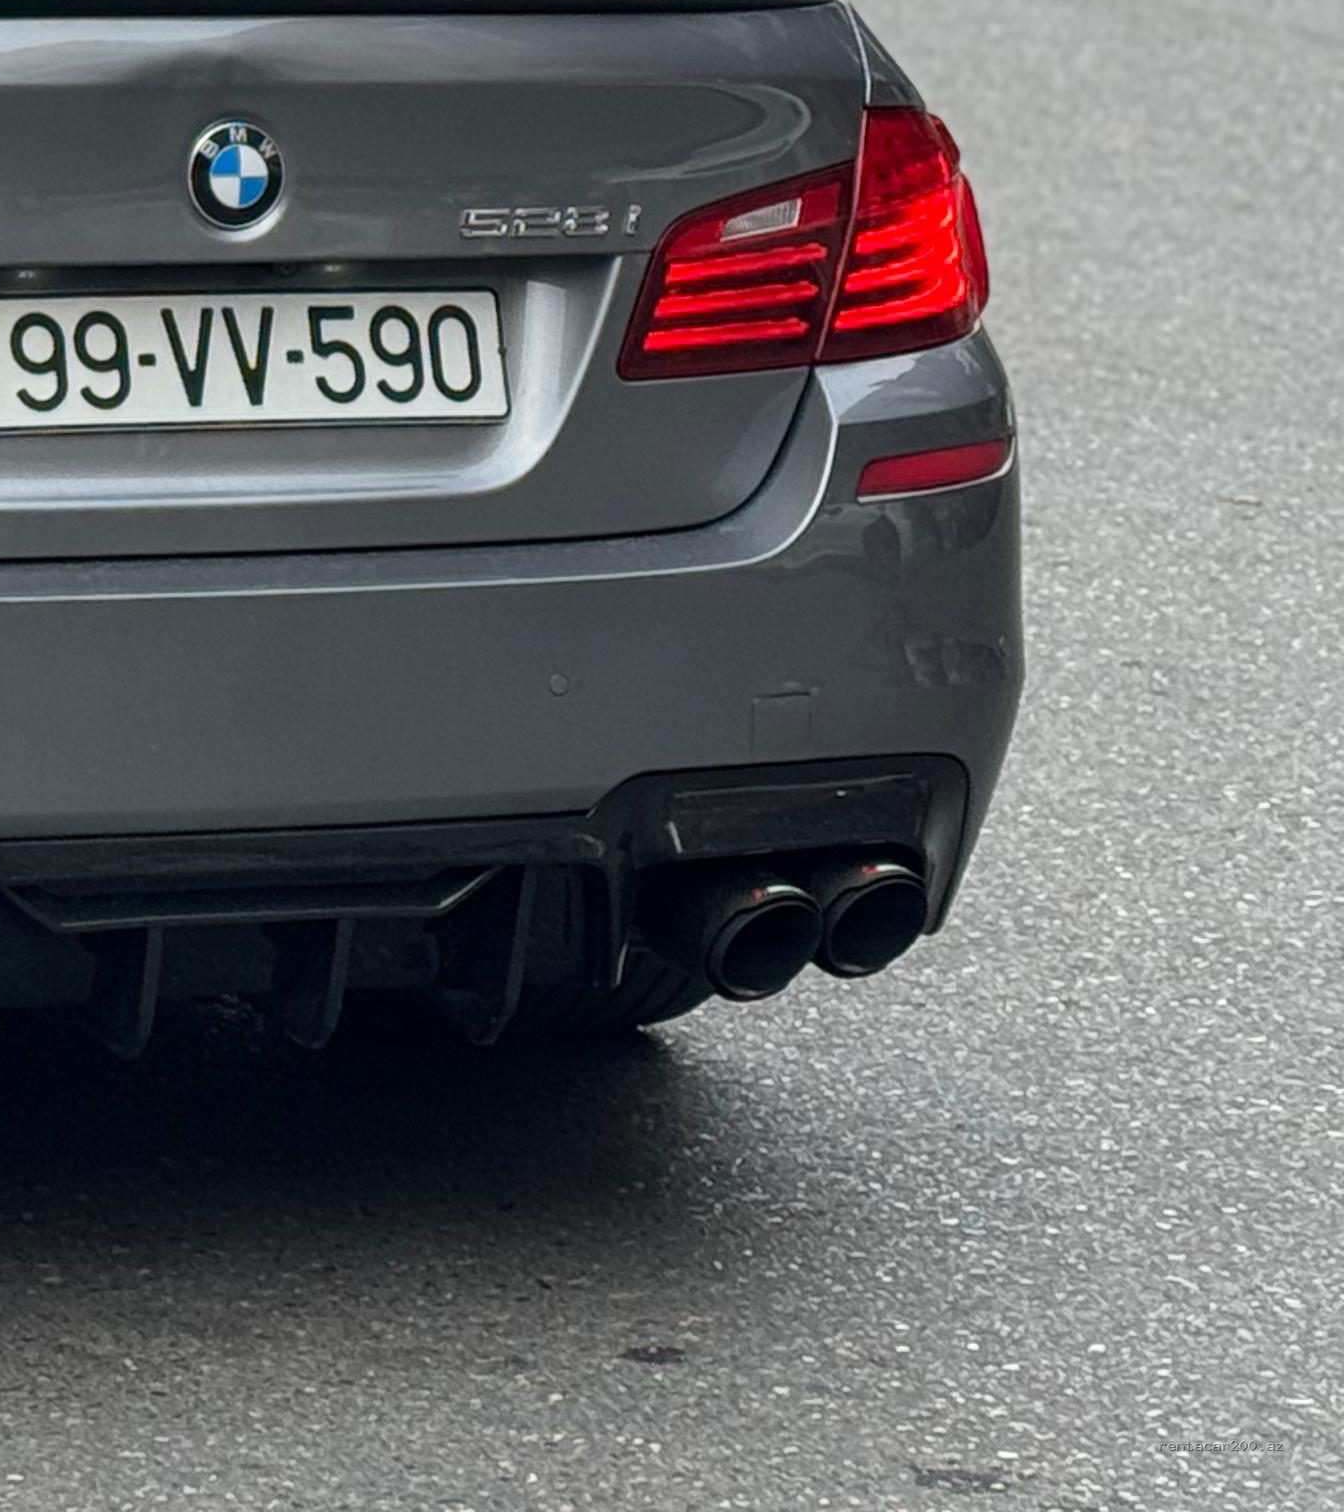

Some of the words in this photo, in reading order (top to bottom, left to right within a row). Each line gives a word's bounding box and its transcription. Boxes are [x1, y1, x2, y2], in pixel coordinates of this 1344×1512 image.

[198, 126, 279, 160] BMW
[461, 194, 642, 238] 528i
[9, 304, 483, 412] 99-VV-590
